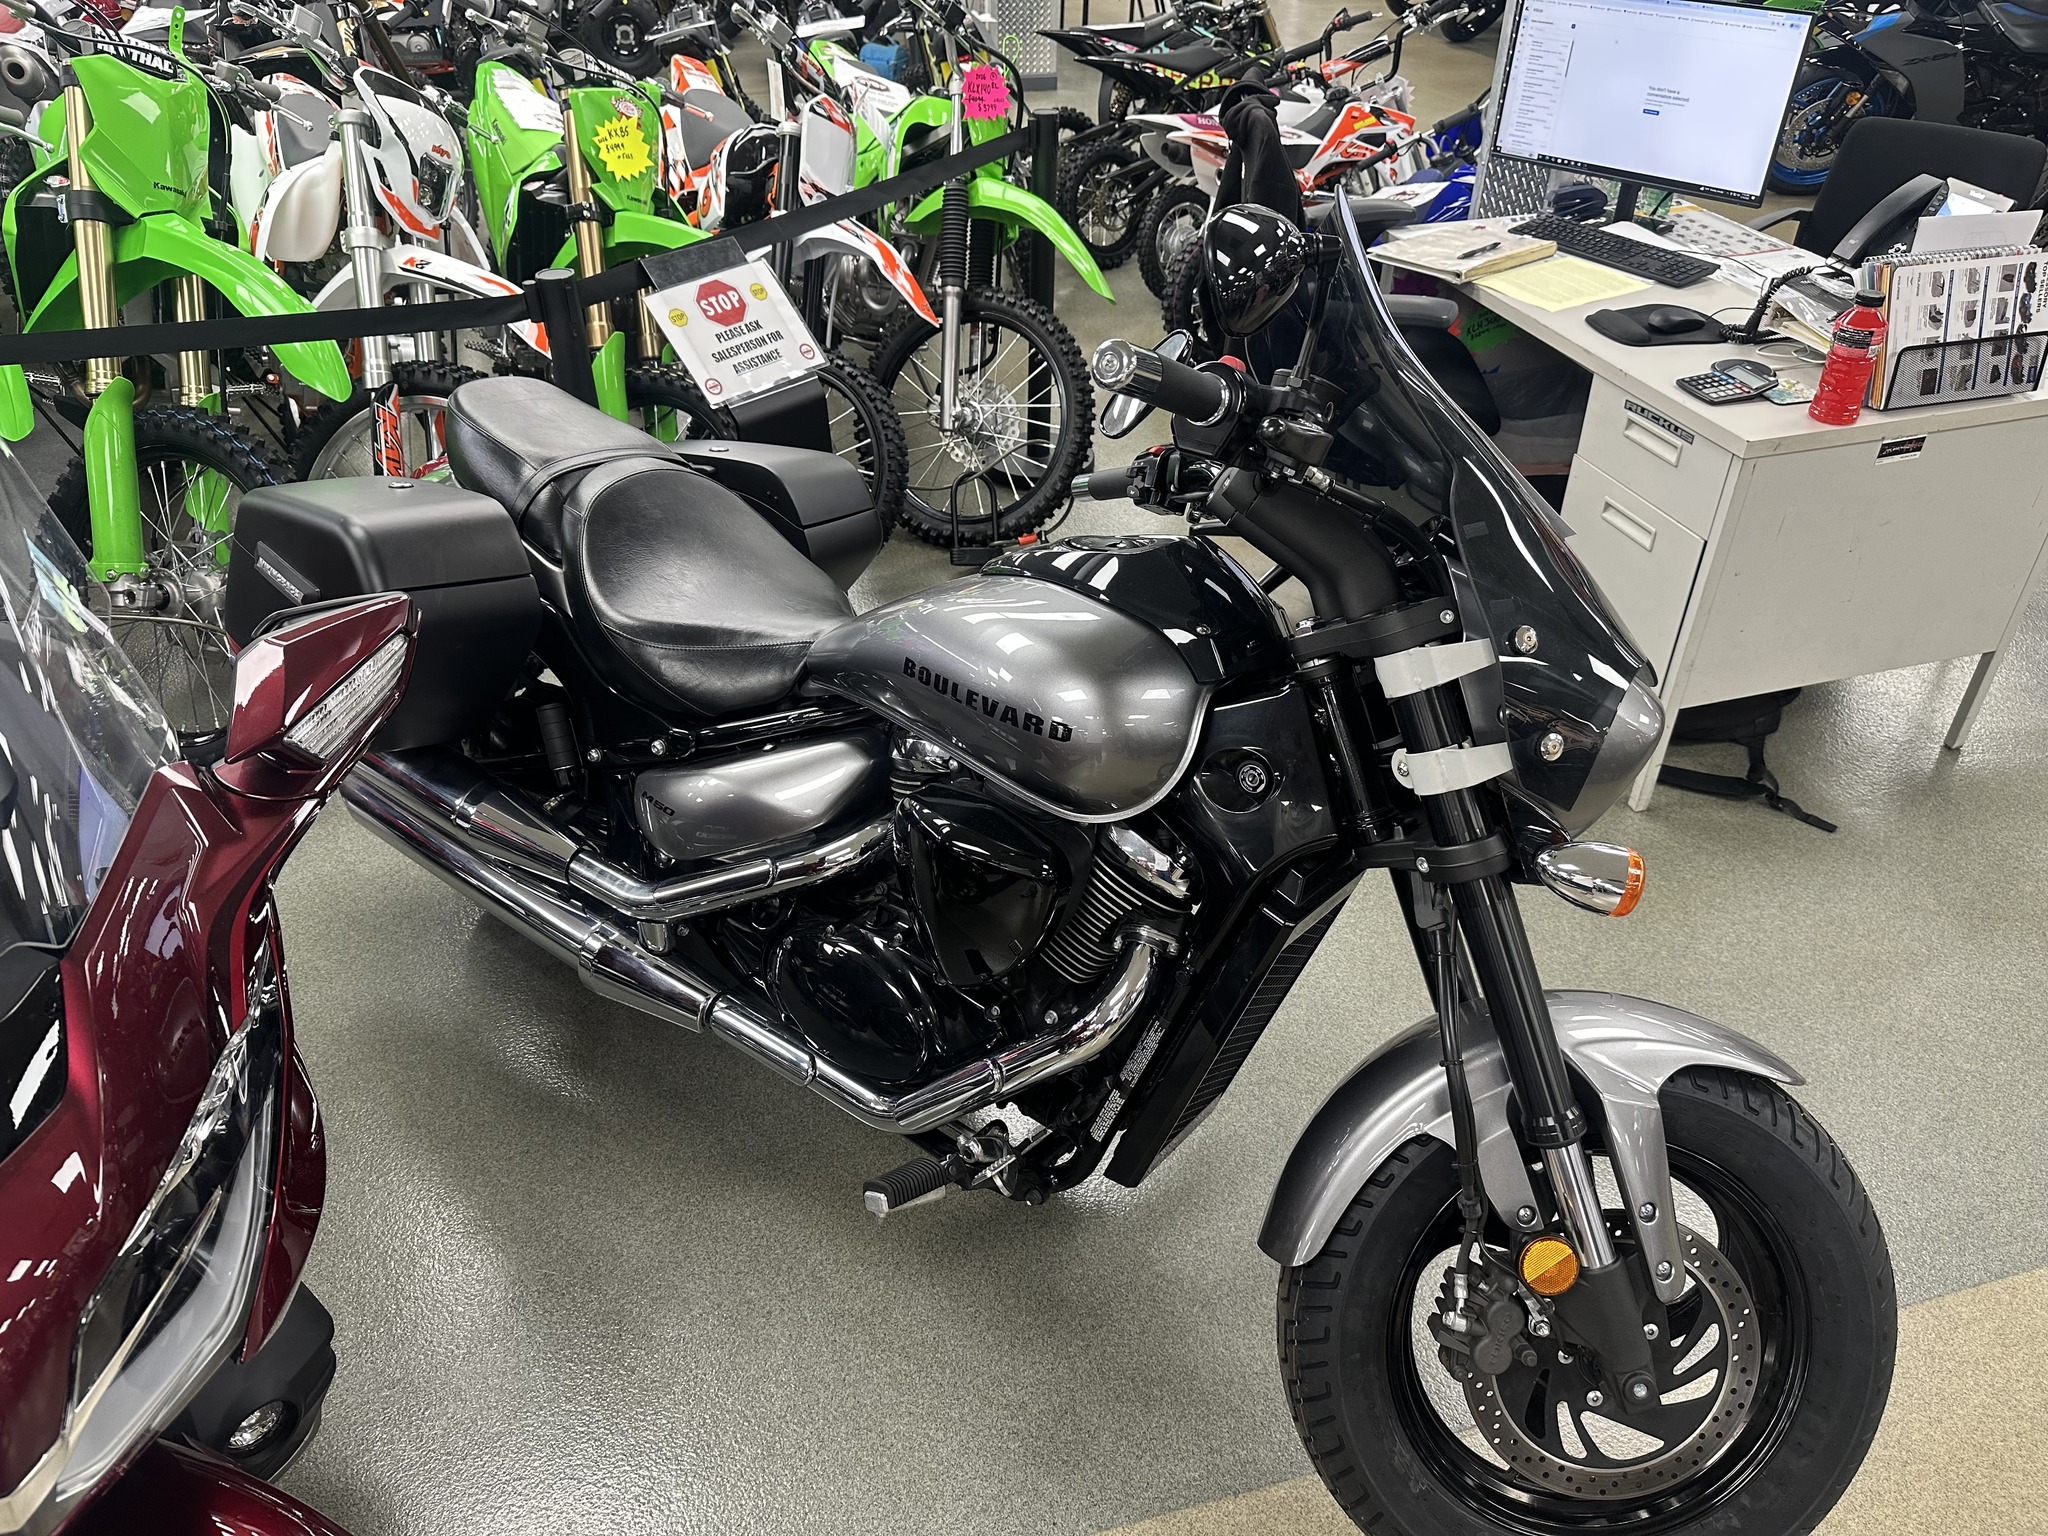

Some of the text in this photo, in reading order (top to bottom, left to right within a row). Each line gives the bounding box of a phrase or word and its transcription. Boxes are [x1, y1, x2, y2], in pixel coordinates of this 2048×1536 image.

[700, 290, 741, 317] STOP
[752, 287, 766, 297] STOP
[2035, 279, 2046, 314] SELLERS
[671, 312, 686, 323] STOP
[715, 319, 763, 344] PLEASE ASK
[711, 330, 784, 364] SALESPERSON FOR
[732, 348, 783, 375] ASSISTANCE
[1625, 401, 1694, 444] RUCKUS
[902, 656, 1074, 743] BOULEVARD
[641, 790, 676, 817] M50
